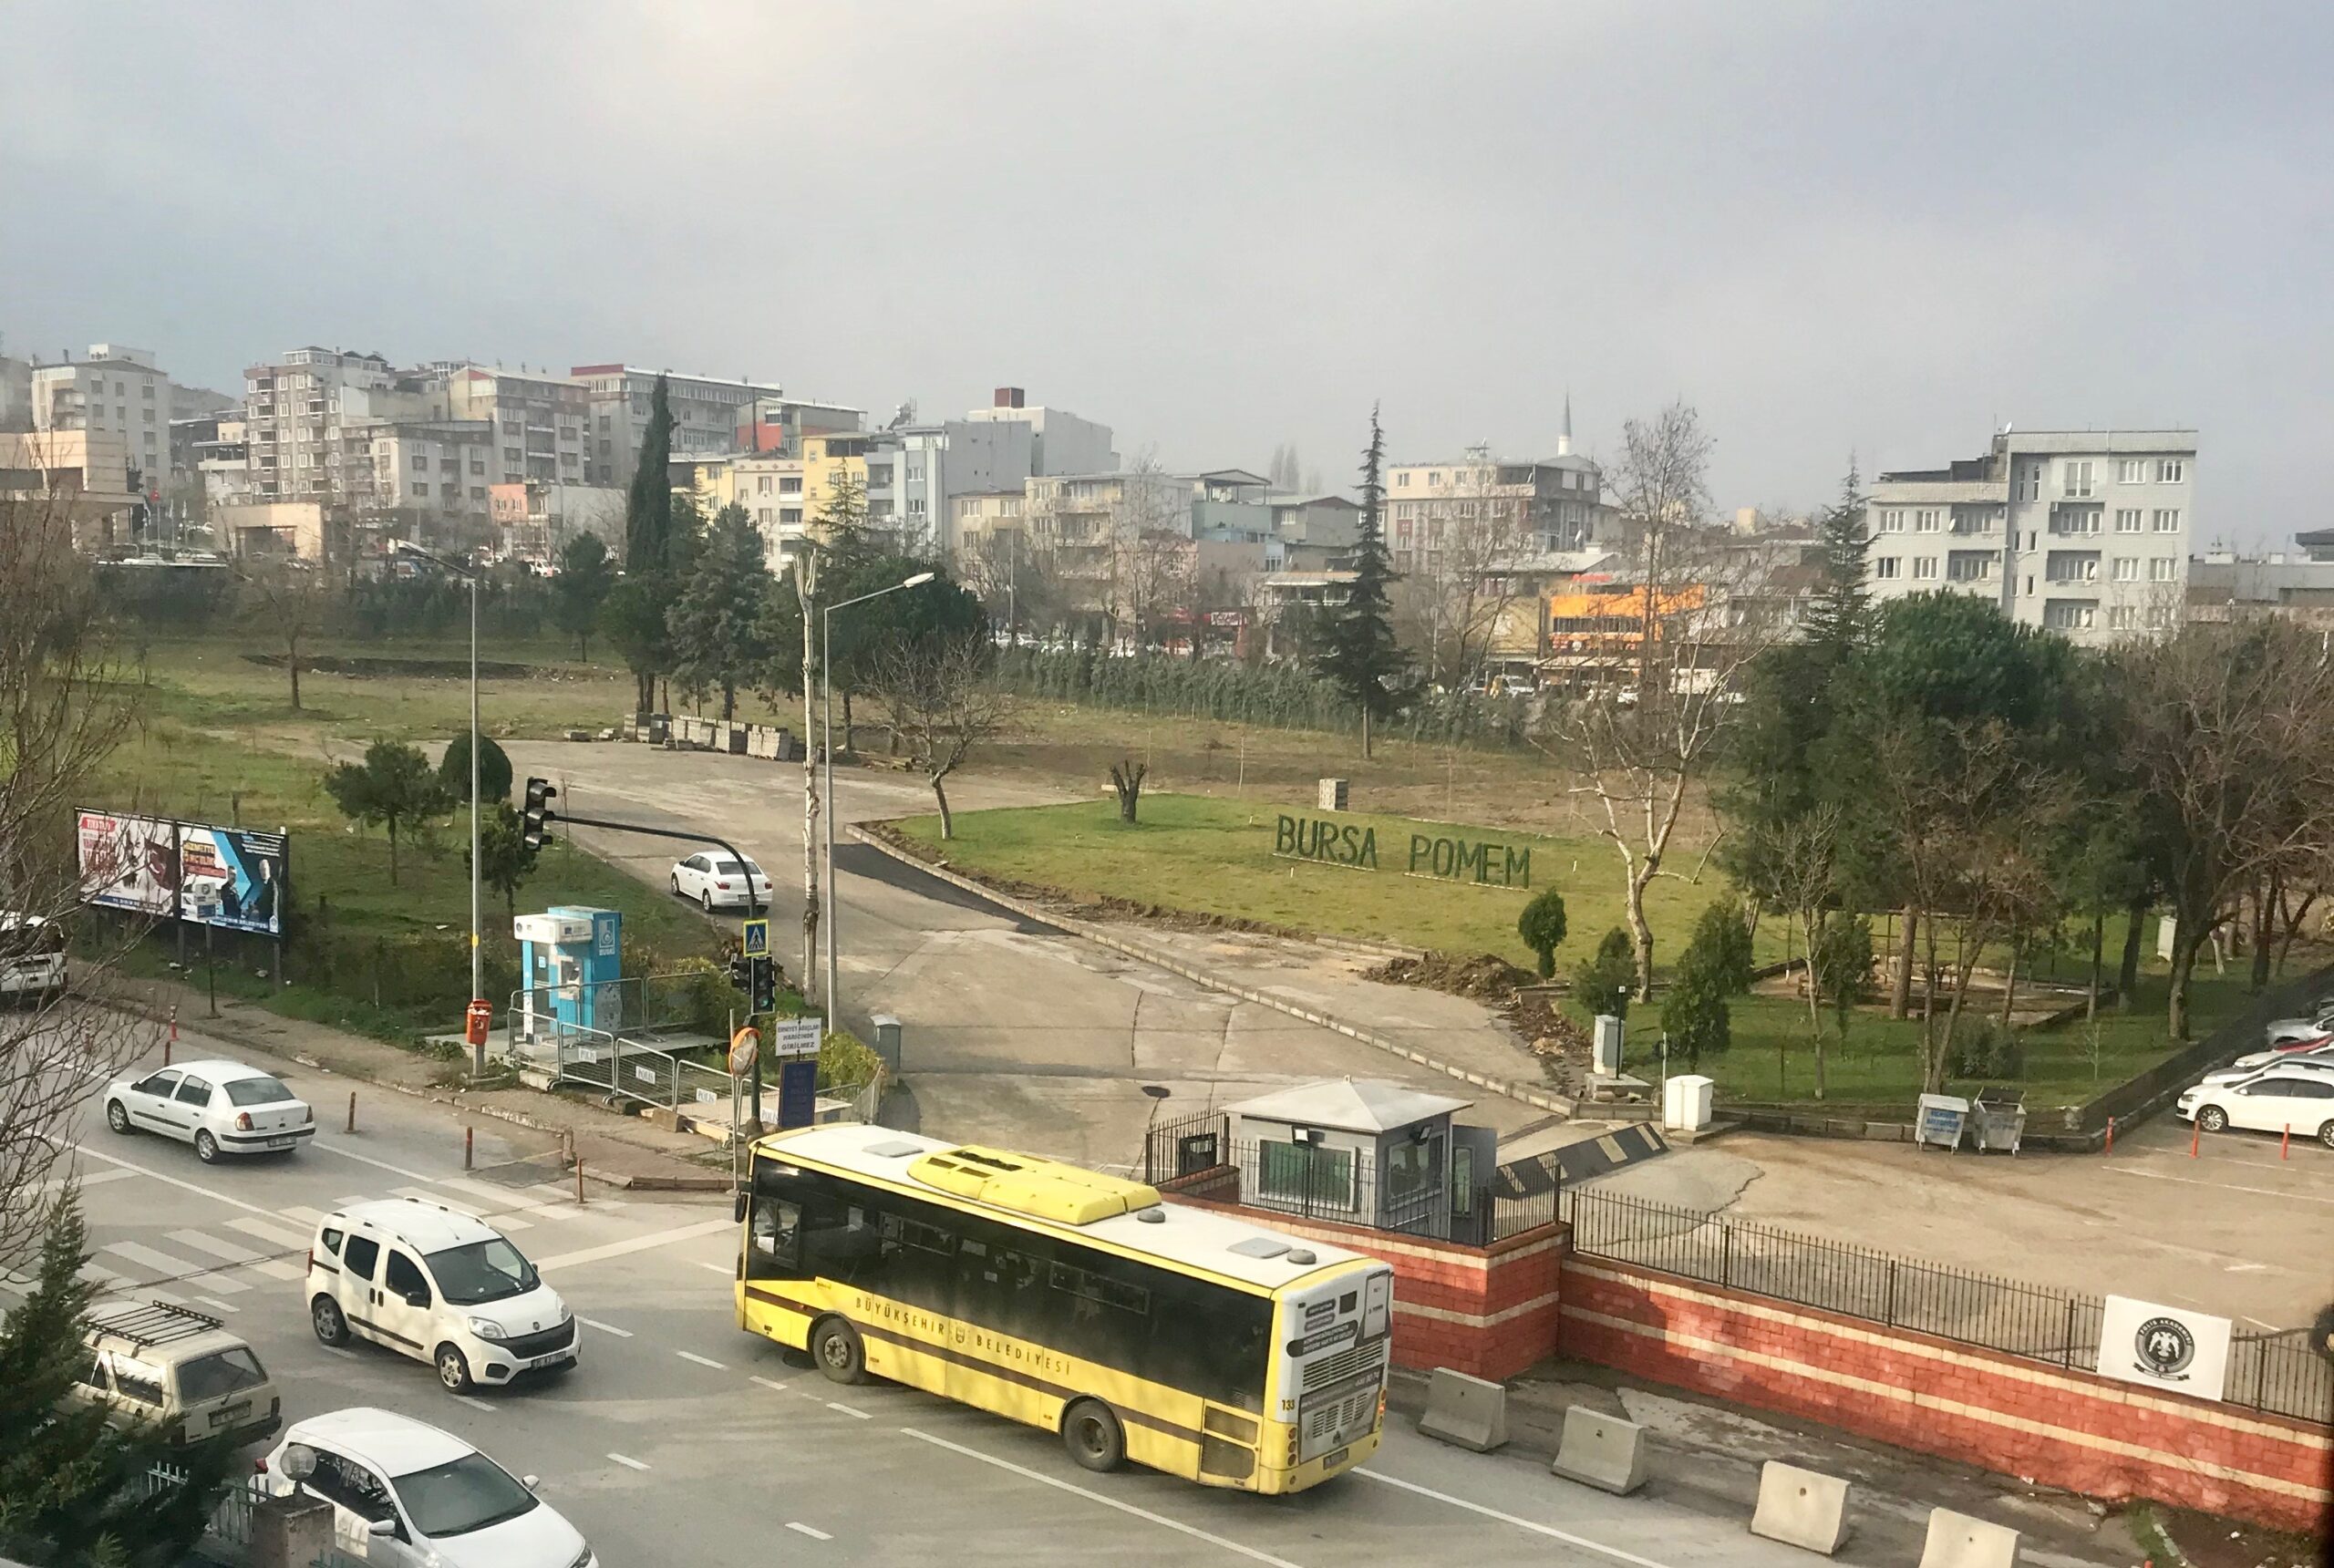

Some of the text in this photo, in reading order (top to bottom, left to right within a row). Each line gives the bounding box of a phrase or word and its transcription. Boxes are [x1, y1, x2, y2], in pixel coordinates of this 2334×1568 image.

[1276, 814, 1530, 890] BURSA POMEM
[855, 1296, 1070, 1376] BÜYÜKŞEHİR BELEDİYESİ
